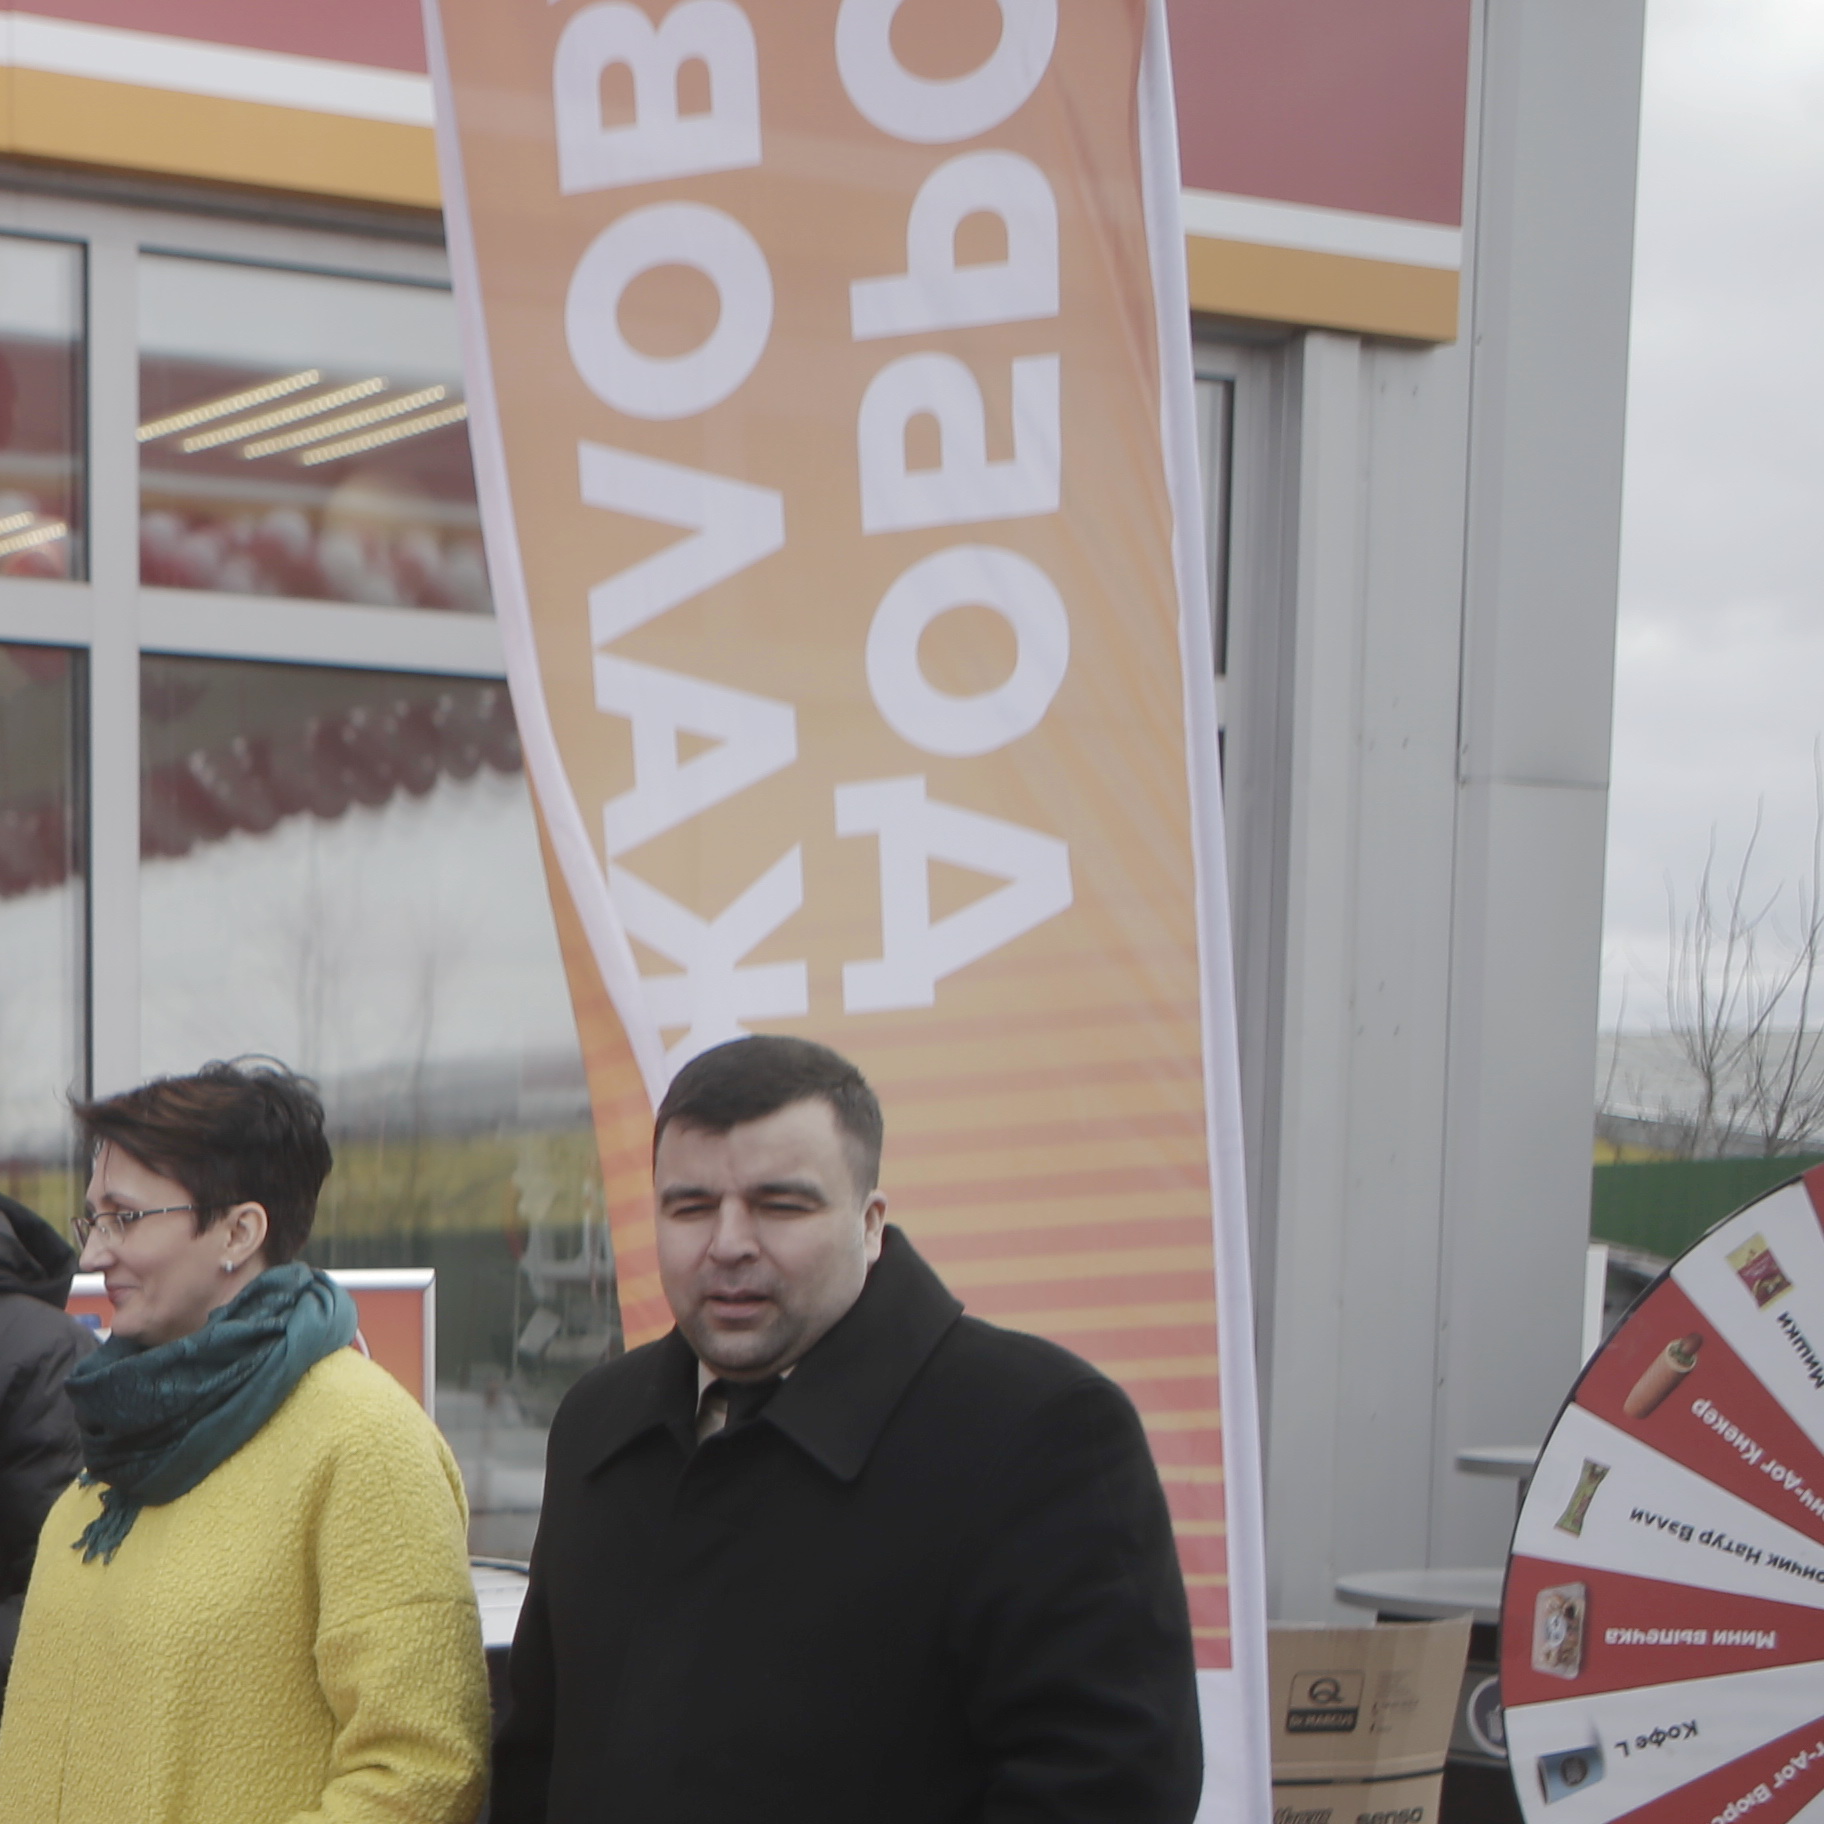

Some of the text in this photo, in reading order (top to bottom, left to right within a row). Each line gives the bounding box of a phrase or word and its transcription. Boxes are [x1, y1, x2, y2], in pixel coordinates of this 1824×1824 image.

[1690, 1398, 1824, 1523] нч-дог Кнекер
[1629, 1506, 1824, 1584] ончик Натур Вэлли
[1605, 1627, 1778, 1650] Мини выпечка
[1615, 1719, 1699, 1757] Кофе L
[1773, 1741, 1824, 1790] т-дог
